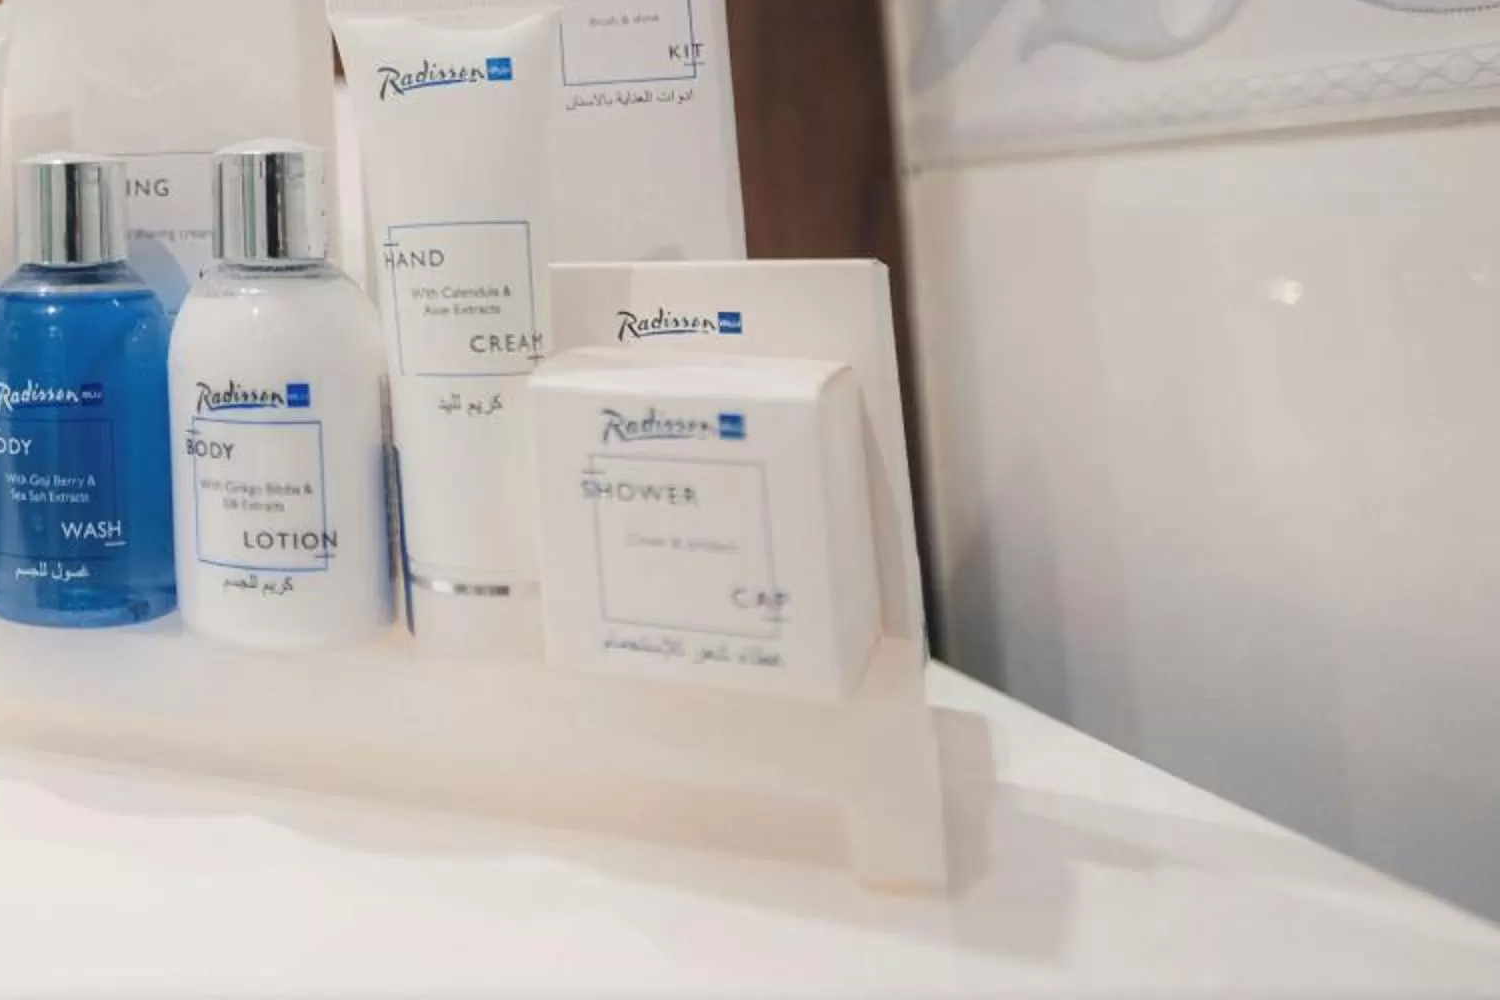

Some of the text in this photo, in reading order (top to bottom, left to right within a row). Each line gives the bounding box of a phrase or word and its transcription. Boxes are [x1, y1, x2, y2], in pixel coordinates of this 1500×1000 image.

[668, 43, 705, 61] KIT
[377, 58, 485, 101] Radisson
[125, 178, 169, 197] ING
[384, 249, 445, 270] HAND
[617, 306, 716, 341] Radisson
[469, 333, 543, 354] CREAM
[196, 380, 284, 414] Radisson
[186, 439, 234, 460] BODY
[581, 479, 699, 507] SHOWER
[60, 519, 122, 540] WASH
[243, 529, 338, 551] LOTION
